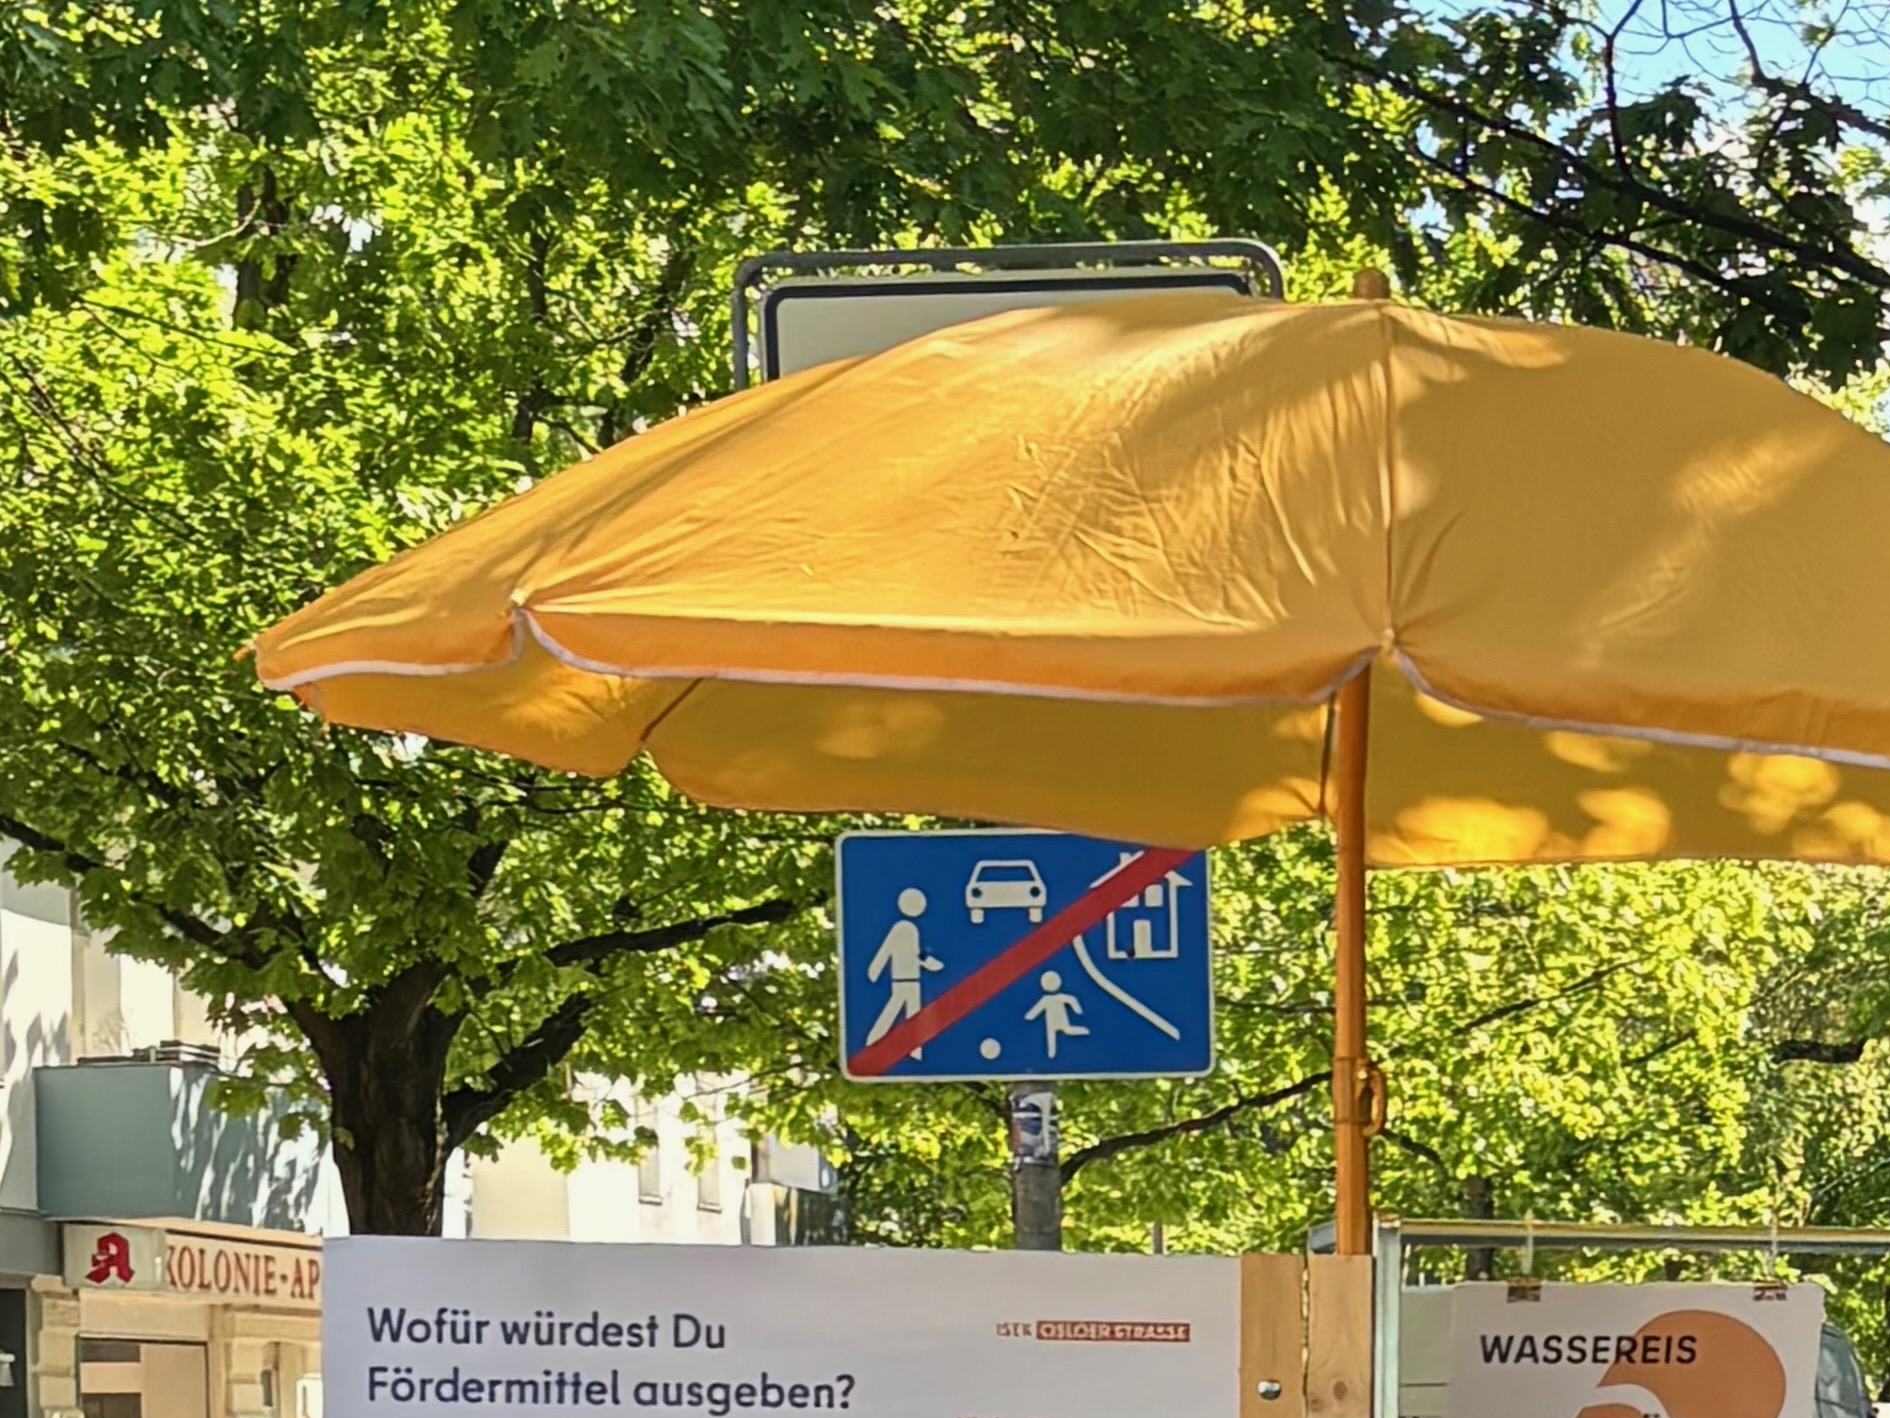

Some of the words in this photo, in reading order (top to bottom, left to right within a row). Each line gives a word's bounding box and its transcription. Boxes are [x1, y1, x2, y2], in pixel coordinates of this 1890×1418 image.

[368, 1306, 489, 1344] Wofür
[501, 1311, 658, 1348] würdest
[674, 1314, 725, 1348] Du
[1040, 1323, 1109, 1338] OSLOER
[1480, 1335, 1697, 1364] WASSEREIS
[368, 1366, 619, 1405] Fördermittel
[634, 1372, 855, 1415] ausgeben?
